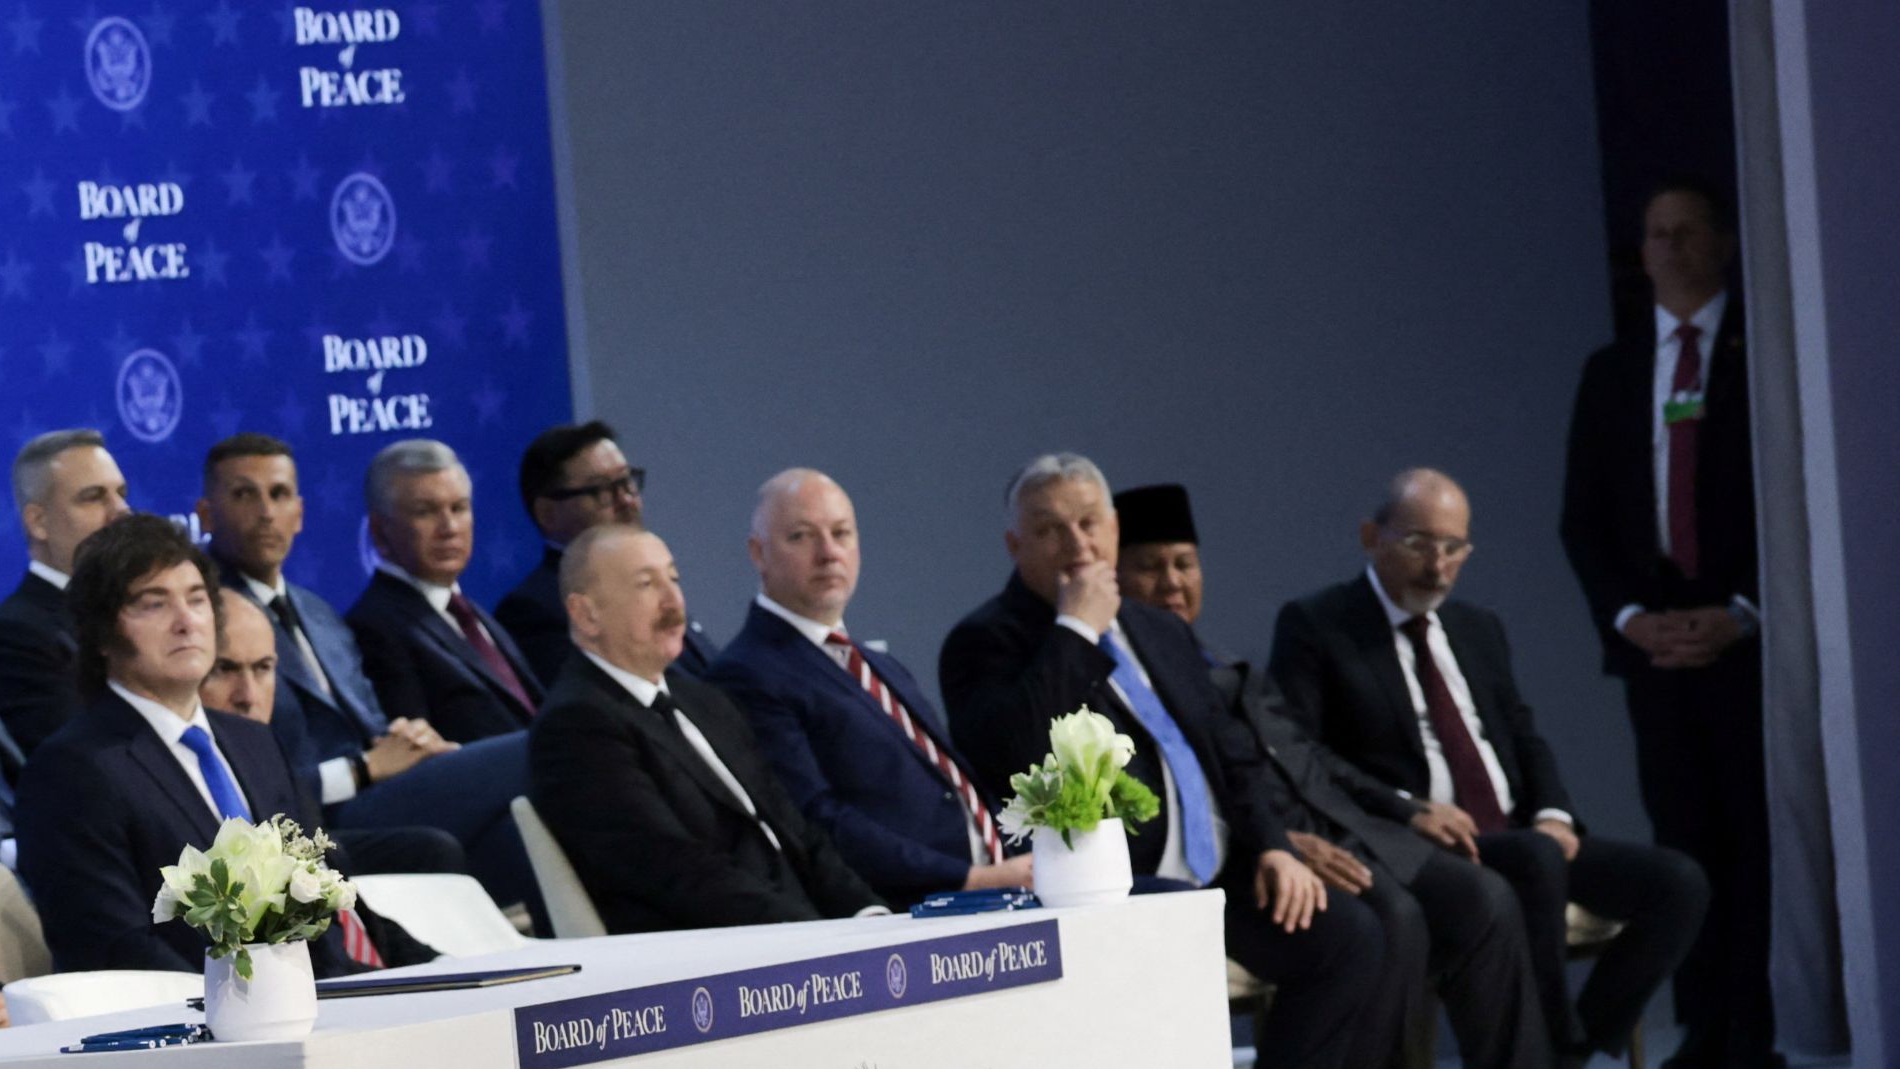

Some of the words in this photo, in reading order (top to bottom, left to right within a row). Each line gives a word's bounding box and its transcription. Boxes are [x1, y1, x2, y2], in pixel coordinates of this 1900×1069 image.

[293, 7, 400, 46] BOARD
[338, 44, 356, 68] of
[299, 66, 405, 108] PEACE
[78, 181, 184, 220] BOARD
[123, 218, 141, 243] of
[84, 243, 189, 284] PEACE
[322, 334, 428, 374] BOARD
[366, 371, 384, 394] of
[328, 394, 433, 435] PEACE
[930, 951, 984, 984] BOARD
[985, 948, 998, 982] of
[998, 940, 1047, 973] PEACE
[738, 983, 795, 1018] BOARD
[797, 980, 810, 1015] of
[811, 971, 863, 1005] PEACE
[533, 1021, 594, 1054] BOARD
[596, 1014, 610, 1050] of
[611, 1005, 667, 1040] PEACE
